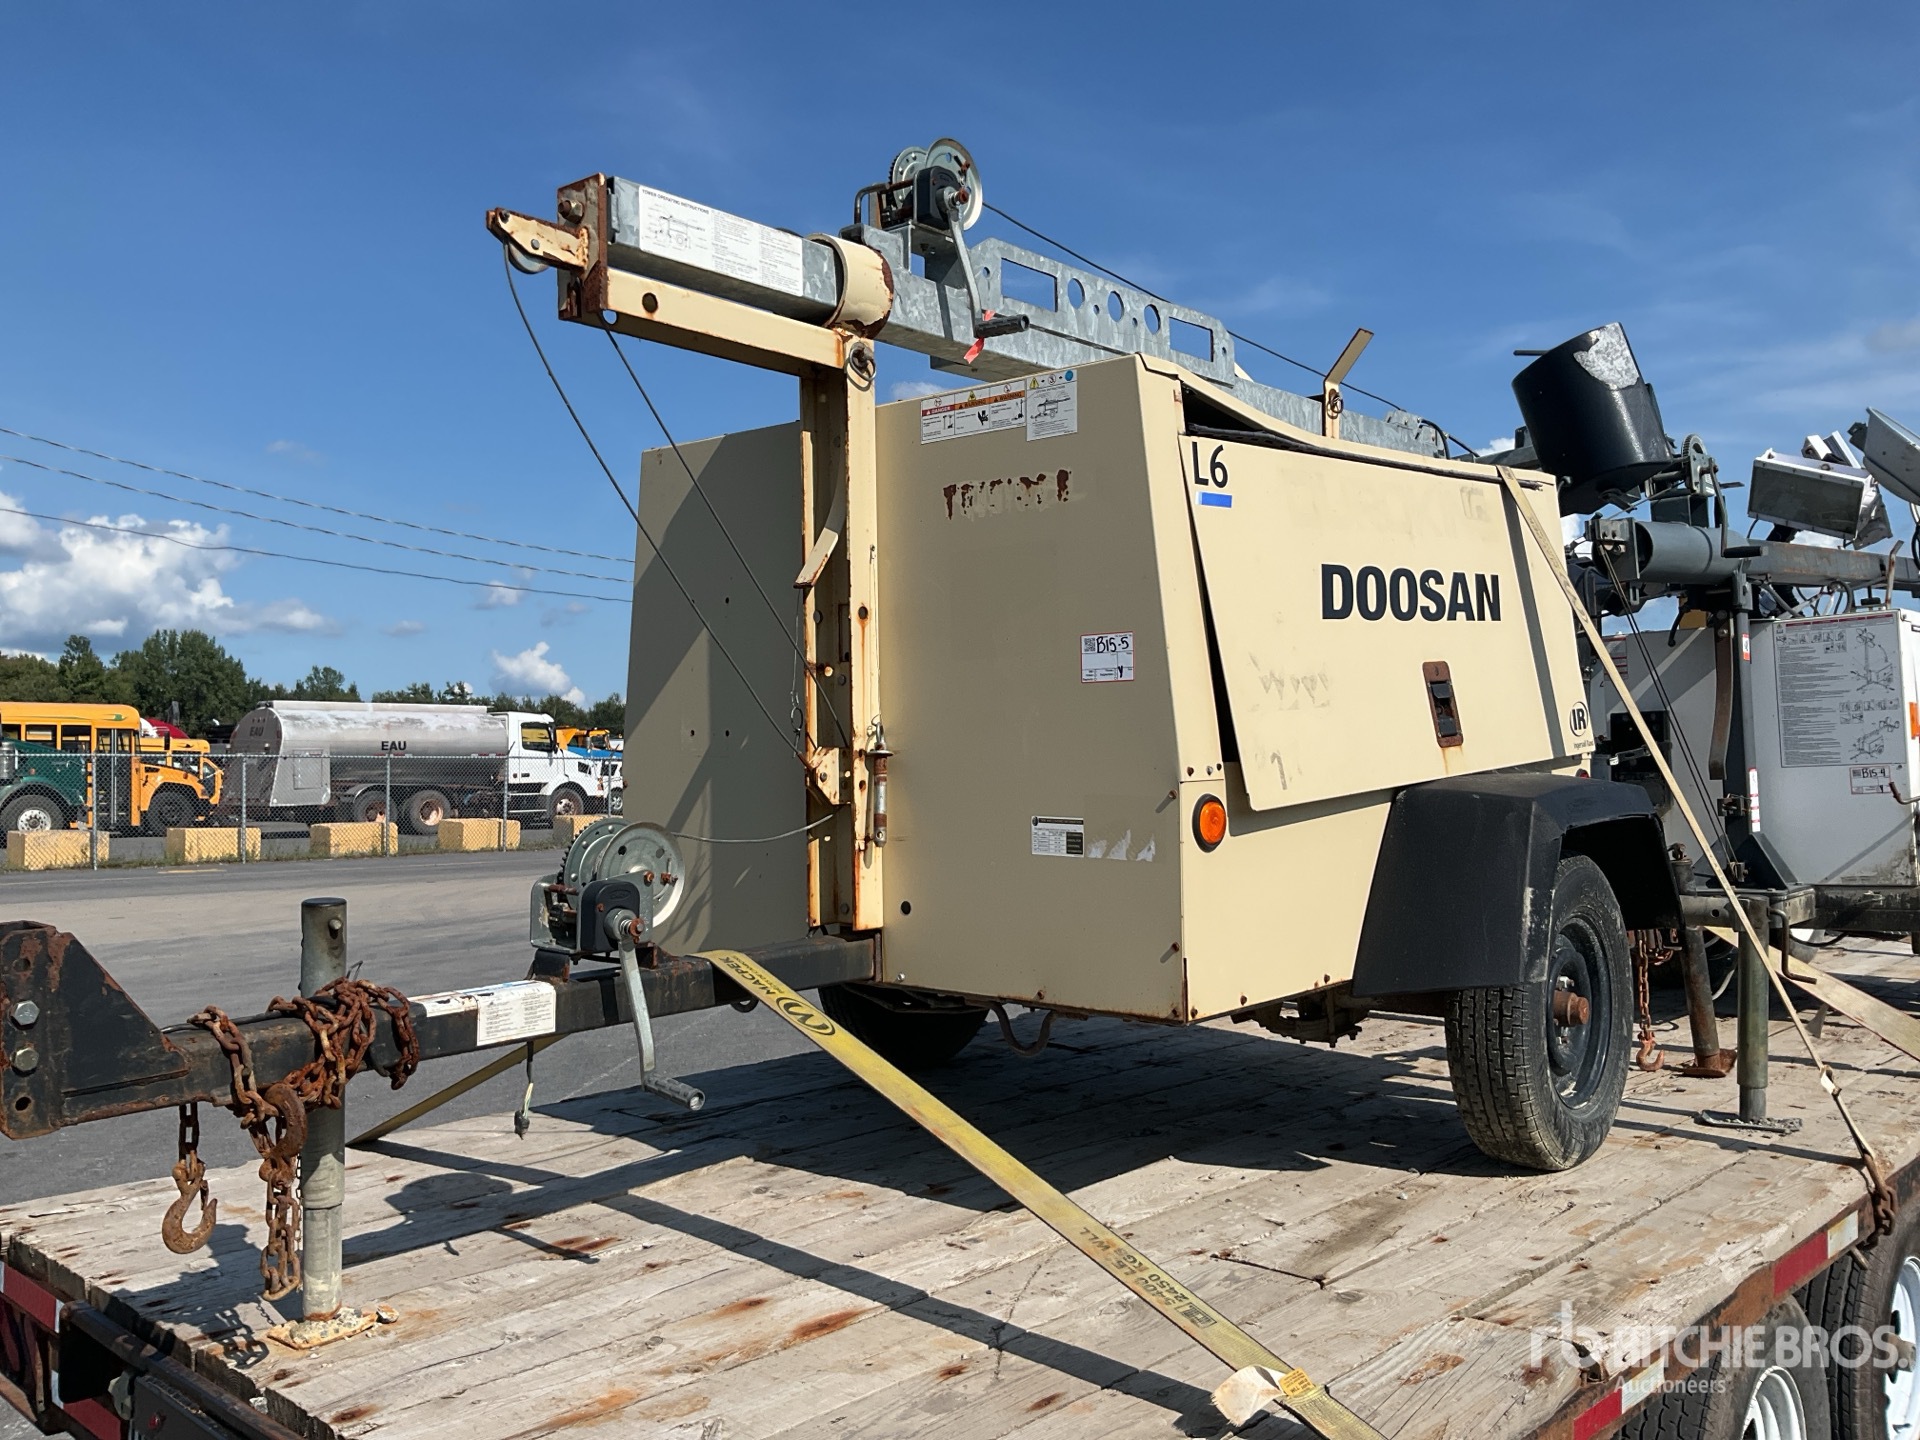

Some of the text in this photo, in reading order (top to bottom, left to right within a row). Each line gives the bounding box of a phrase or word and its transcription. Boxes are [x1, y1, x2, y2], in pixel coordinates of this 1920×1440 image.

[641, 188, 657, 198] TOWER
[657, 193, 681, 206] OPERATING
[1192, 441, 1228, 488] L6
[1321, 563, 1501, 622] DOOSAN
[1572, 708, 1587, 730] IR
[381, 741, 407, 751] EAU
[719, 956, 777, 995] MACPEK
[1080, 1226, 1111, 1252] WLL
[1147, 1273, 1189, 1303] 2450
